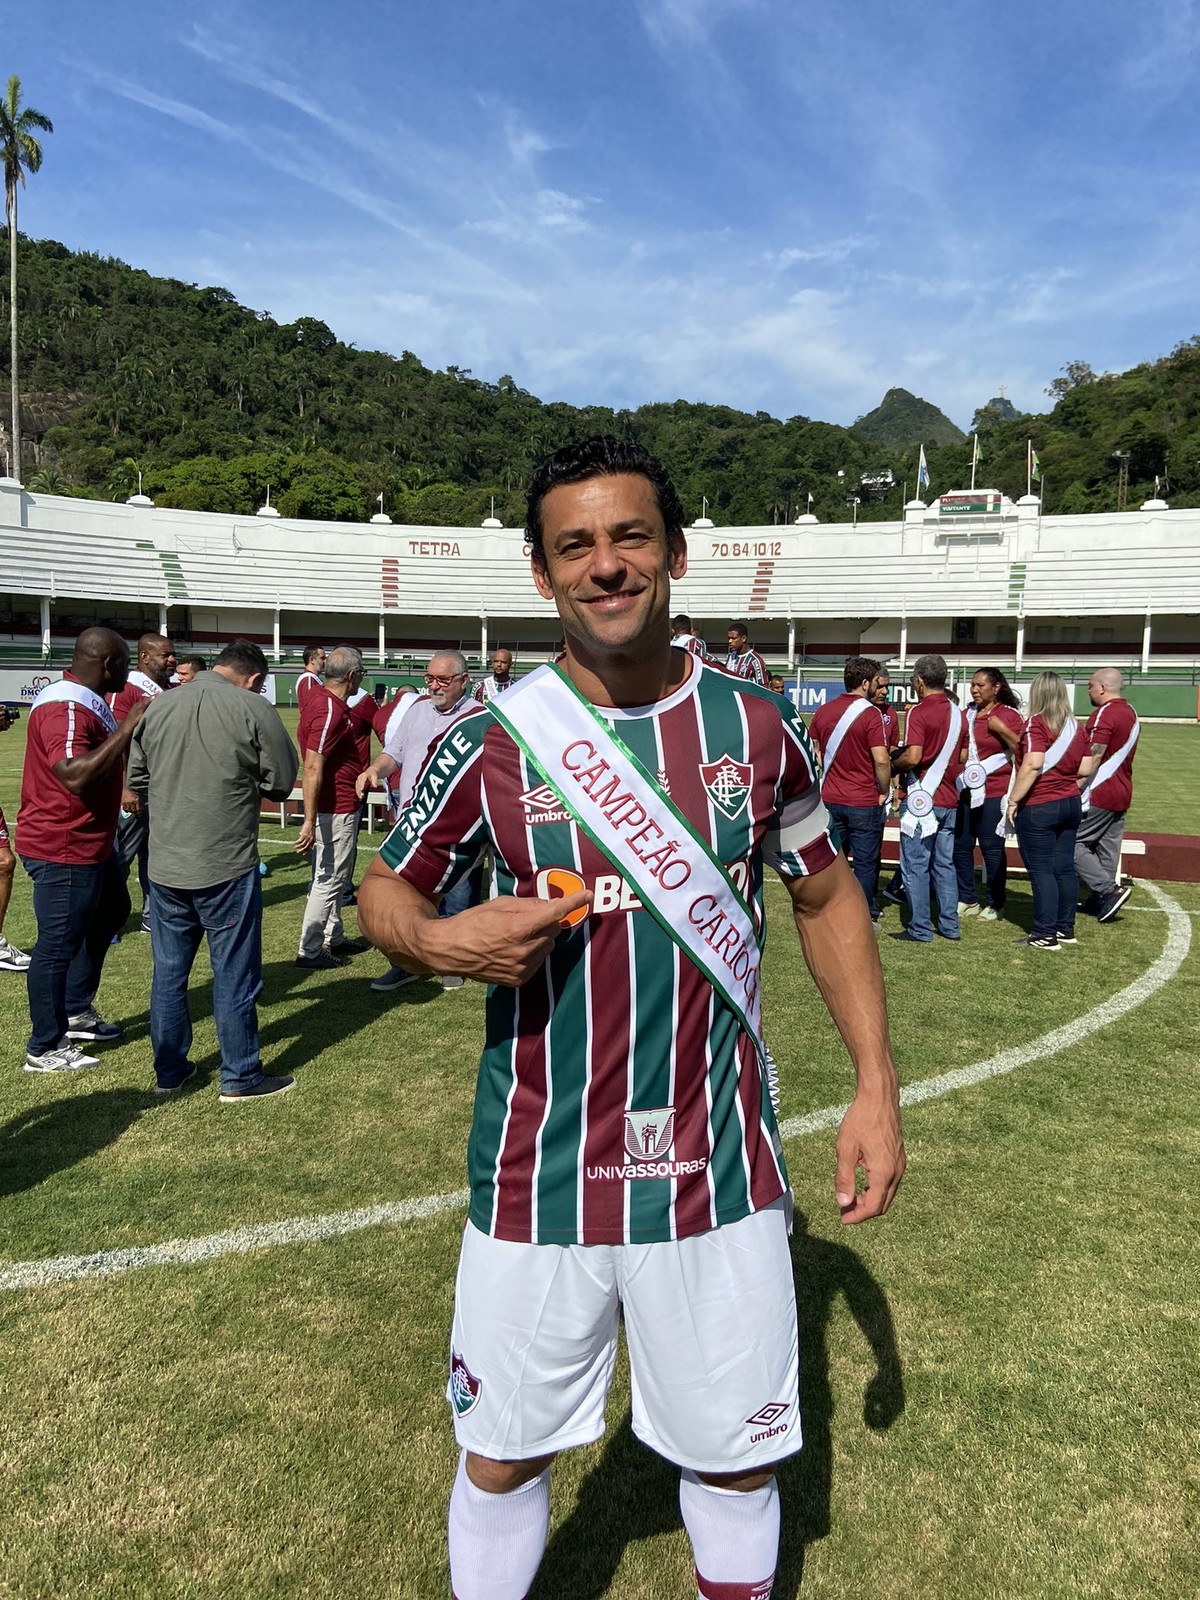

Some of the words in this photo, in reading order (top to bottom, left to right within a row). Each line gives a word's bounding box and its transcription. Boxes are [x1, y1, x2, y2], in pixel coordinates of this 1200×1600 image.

[409, 541, 461, 556] TETRA
[788, 687, 827, 706] TIM
[561, 739, 692, 890] CAMPEÃO
[750, 1423, 788, 1444] umbro
